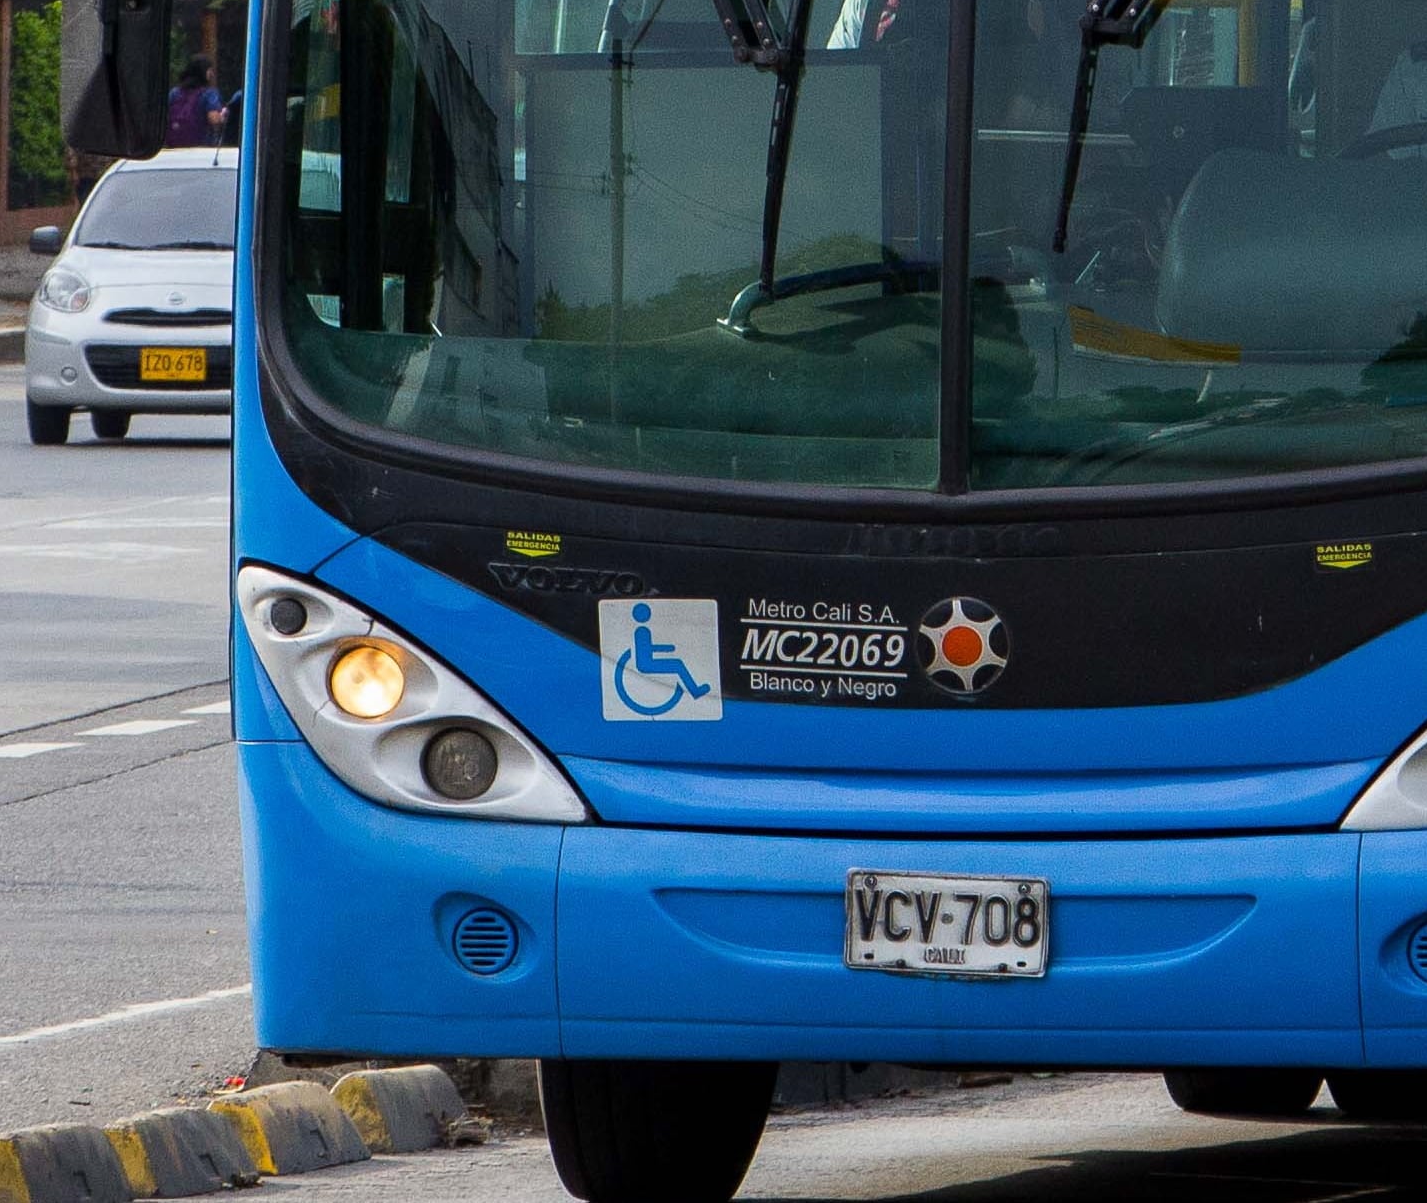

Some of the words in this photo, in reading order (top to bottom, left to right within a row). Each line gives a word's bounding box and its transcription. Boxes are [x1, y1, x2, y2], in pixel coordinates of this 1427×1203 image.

[506, 540, 560, 551] EMERGENCIA
[507, 531, 561, 543] SALIDAS
[1316, 543, 1372, 553] SALIDAS
[748, 598, 805, 620] Metro
[812, 601, 852, 623] Cali
[858, 604, 901, 625] S.A.
[741, 628, 905, 668] MC22069
[749, 672, 815, 694] Blanco
[821, 679, 831, 699] y
[838, 676, 897, 700] Negro
